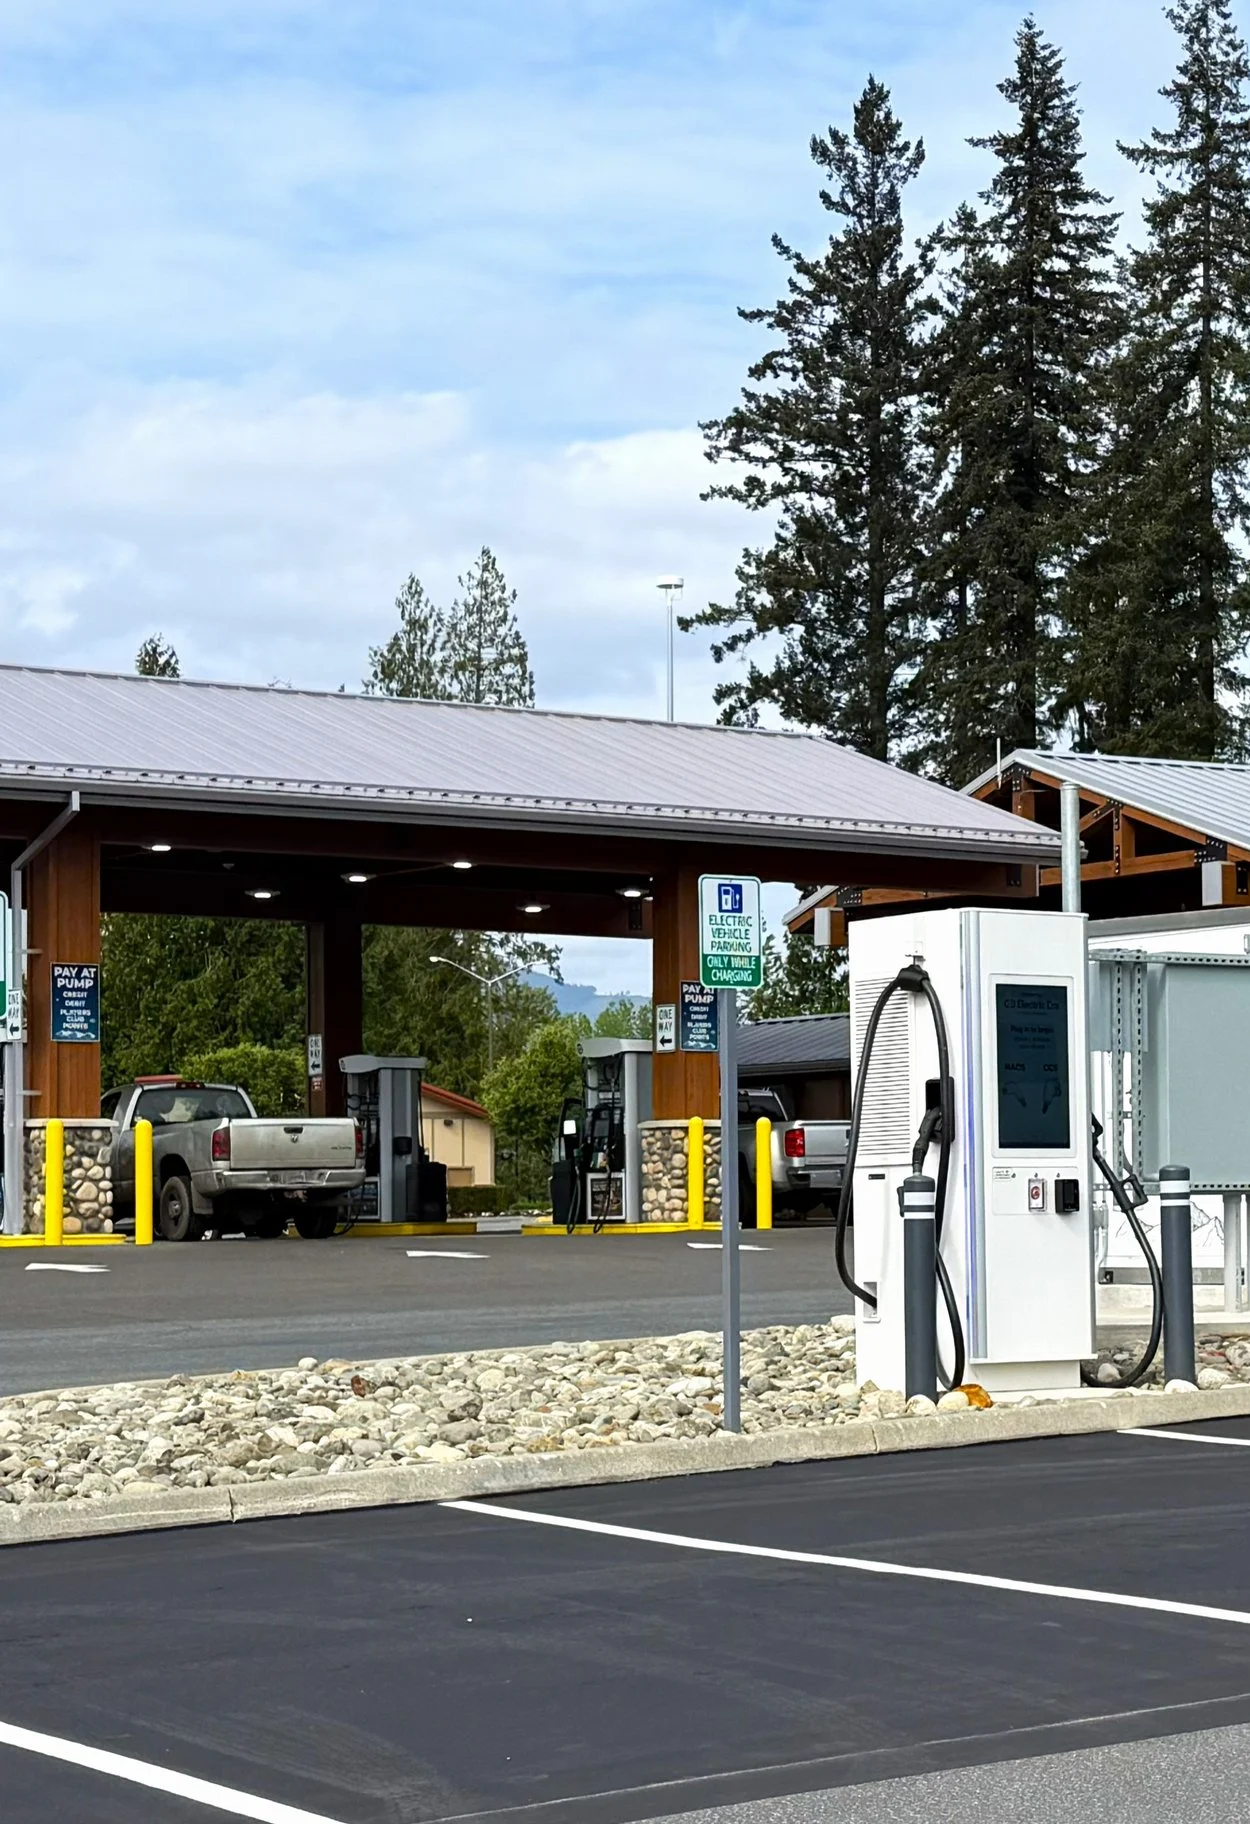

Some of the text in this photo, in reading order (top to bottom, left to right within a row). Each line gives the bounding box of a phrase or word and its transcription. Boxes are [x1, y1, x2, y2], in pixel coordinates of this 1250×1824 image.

[708, 914, 753, 927] ELECTRIC
[711, 927, 750, 940] VEHICLE
[711, 941, 752, 953] PARKING
[706, 956, 756, 969] ONLY WHILE
[54, 966, 97, 978] PAY AT
[711, 969, 752, 982] CHARGING
[57, 978, 94, 989] PUMP
[682, 984, 701, 993] PAY
[684, 994, 714, 1004] PUMP
[659, 1009, 672, 1020] ONE
[659, 1021, 672, 1032] WAY
